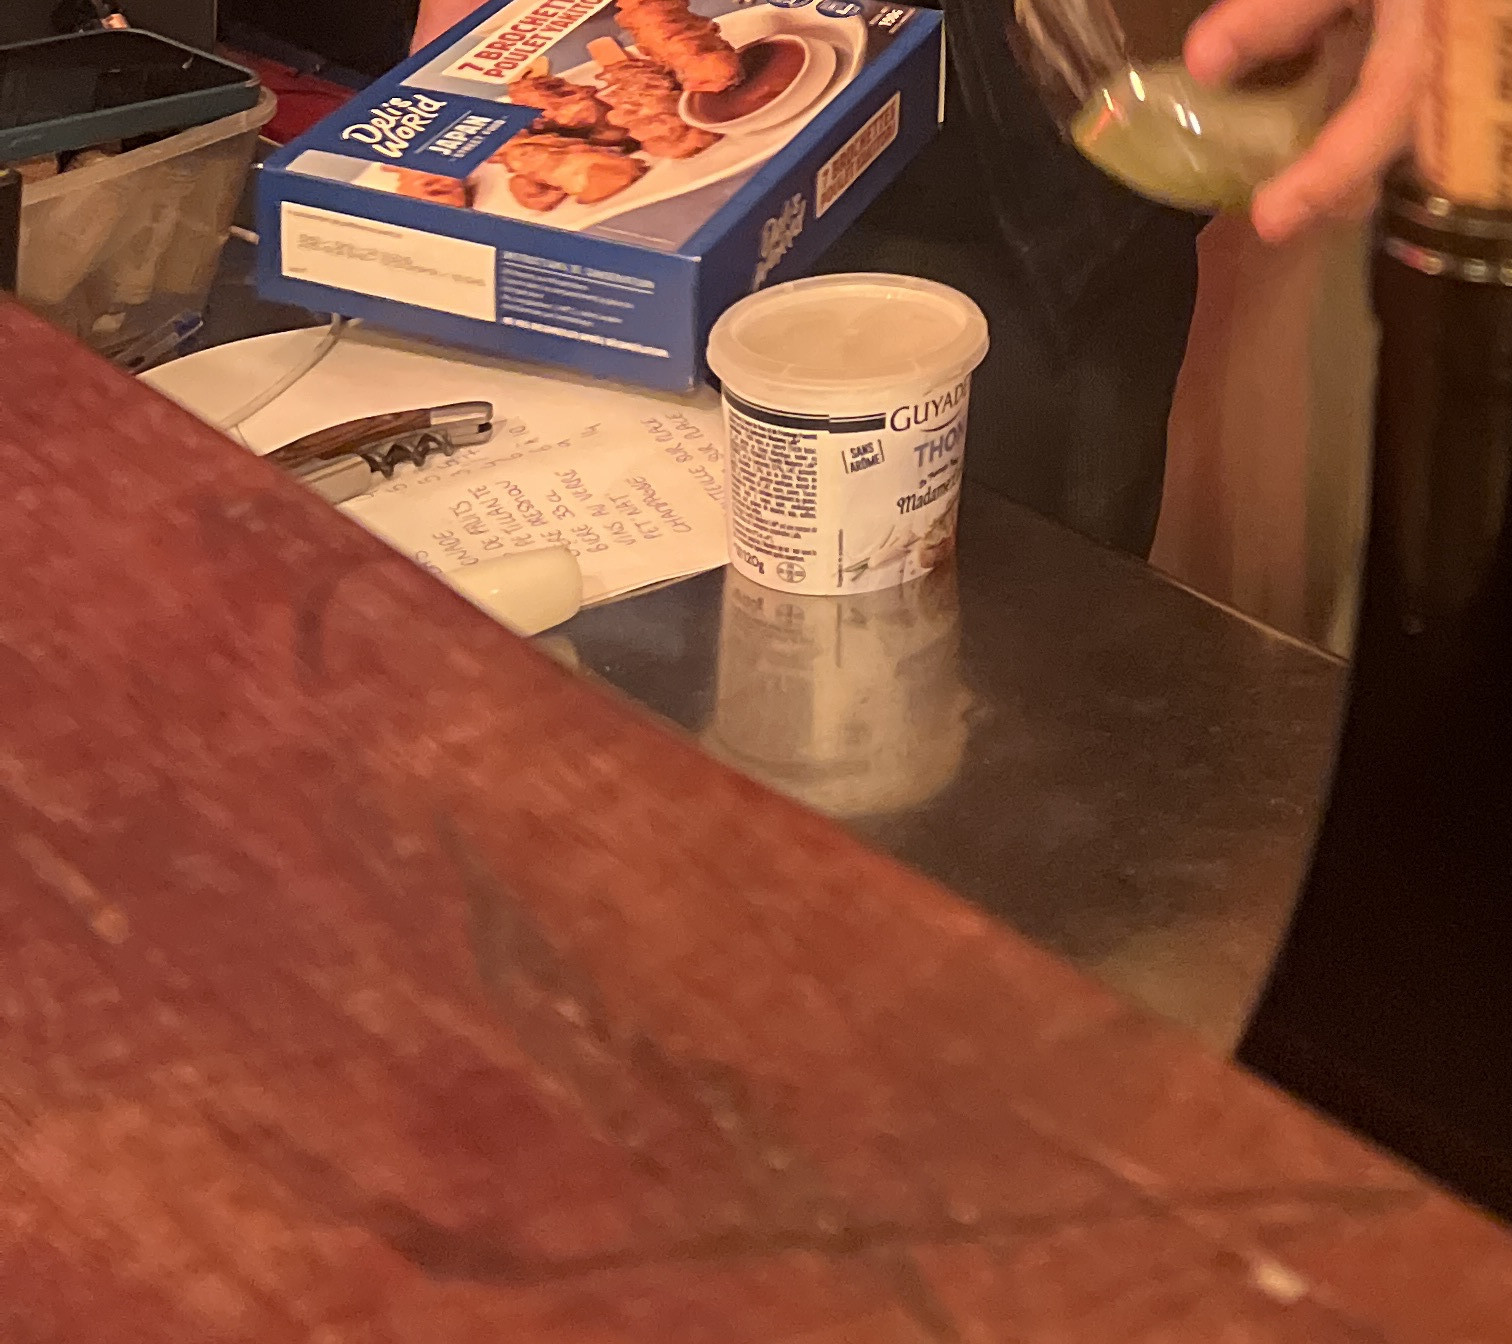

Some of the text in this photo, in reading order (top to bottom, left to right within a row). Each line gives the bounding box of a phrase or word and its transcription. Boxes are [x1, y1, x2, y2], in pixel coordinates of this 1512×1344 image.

[457, 61, 485, 73] 7
[482, 30, 554, 78] POULET
[427, 114, 494, 156] JAPAN
[890, 378, 970, 433] GUYAD
[850, 441, 875, 459] SANS
